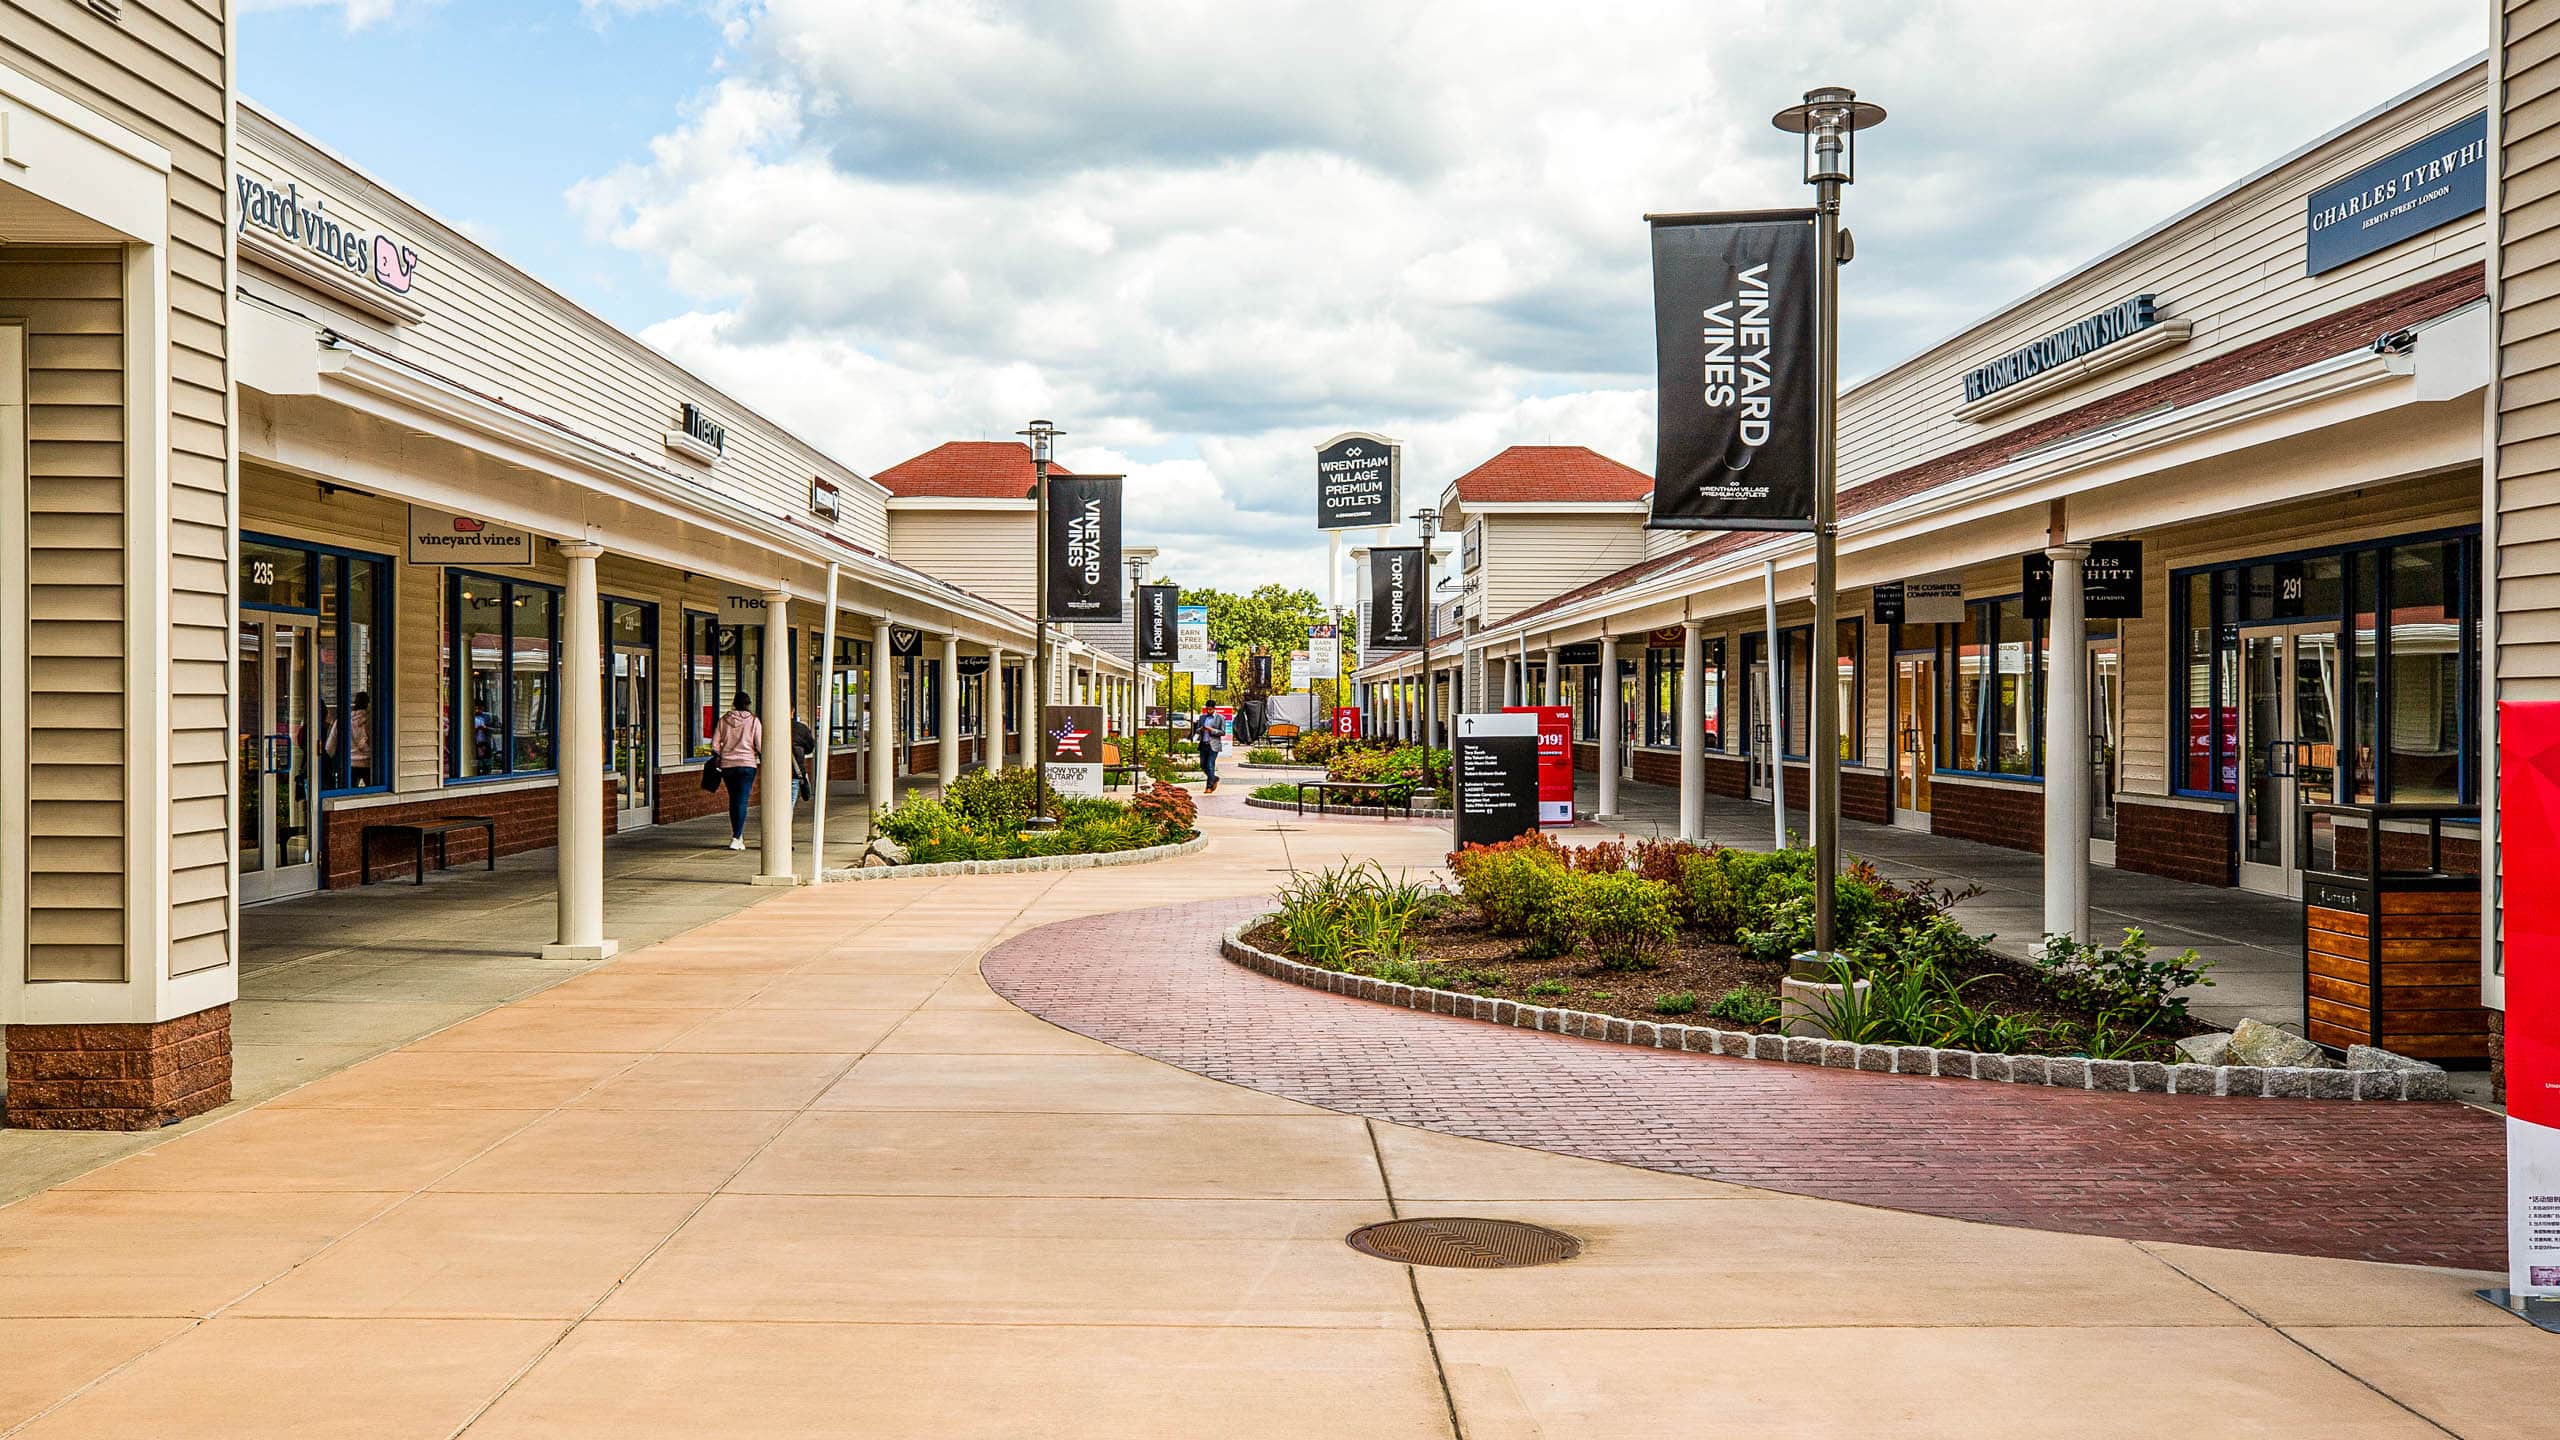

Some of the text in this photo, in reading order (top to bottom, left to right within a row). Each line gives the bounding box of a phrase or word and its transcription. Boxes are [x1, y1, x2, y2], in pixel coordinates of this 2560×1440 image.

[2312, 138, 2487, 232] CHARLES TYRWHI
[2362, 185, 2450, 230] JERMYN STREET LONDON
[236, 174, 368, 274] yard vines
[1703, 300, 1736, 408] VINES
[1738, 263, 1771, 446] VINEYARD
[1963, 297, 2148, 403] THE COSMETICS COMPANY STORE
[690, 405, 725, 457] Theory
[1320, 456, 1388, 472] WRENTHAM
[1330, 470, 1379, 482] VILLAGE
[1326, 482, 1382, 496] PREMIUM
[1326, 494, 1382, 508] OUTLETS
[418, 533, 521, 548] vineyard vines
[1068, 517, 1083, 567] VINES
[1085, 499, 1100, 585] VINEYARD
[254, 562, 274, 585] 235
[1391, 555, 1403, 590] TORY
[2032, 570, 2134, 580] TYHITT
[2283, 577, 2302, 599] 291
[728, 596, 768, 609] Theo
[1154, 592, 1163, 617] TORY
[1392, 590, 1403, 632] BURCH
[1154, 618, 1163, 650] BURCH
[1340, 716, 1352, 733] 8
[2326, 894, 2350, 904] LITTER
